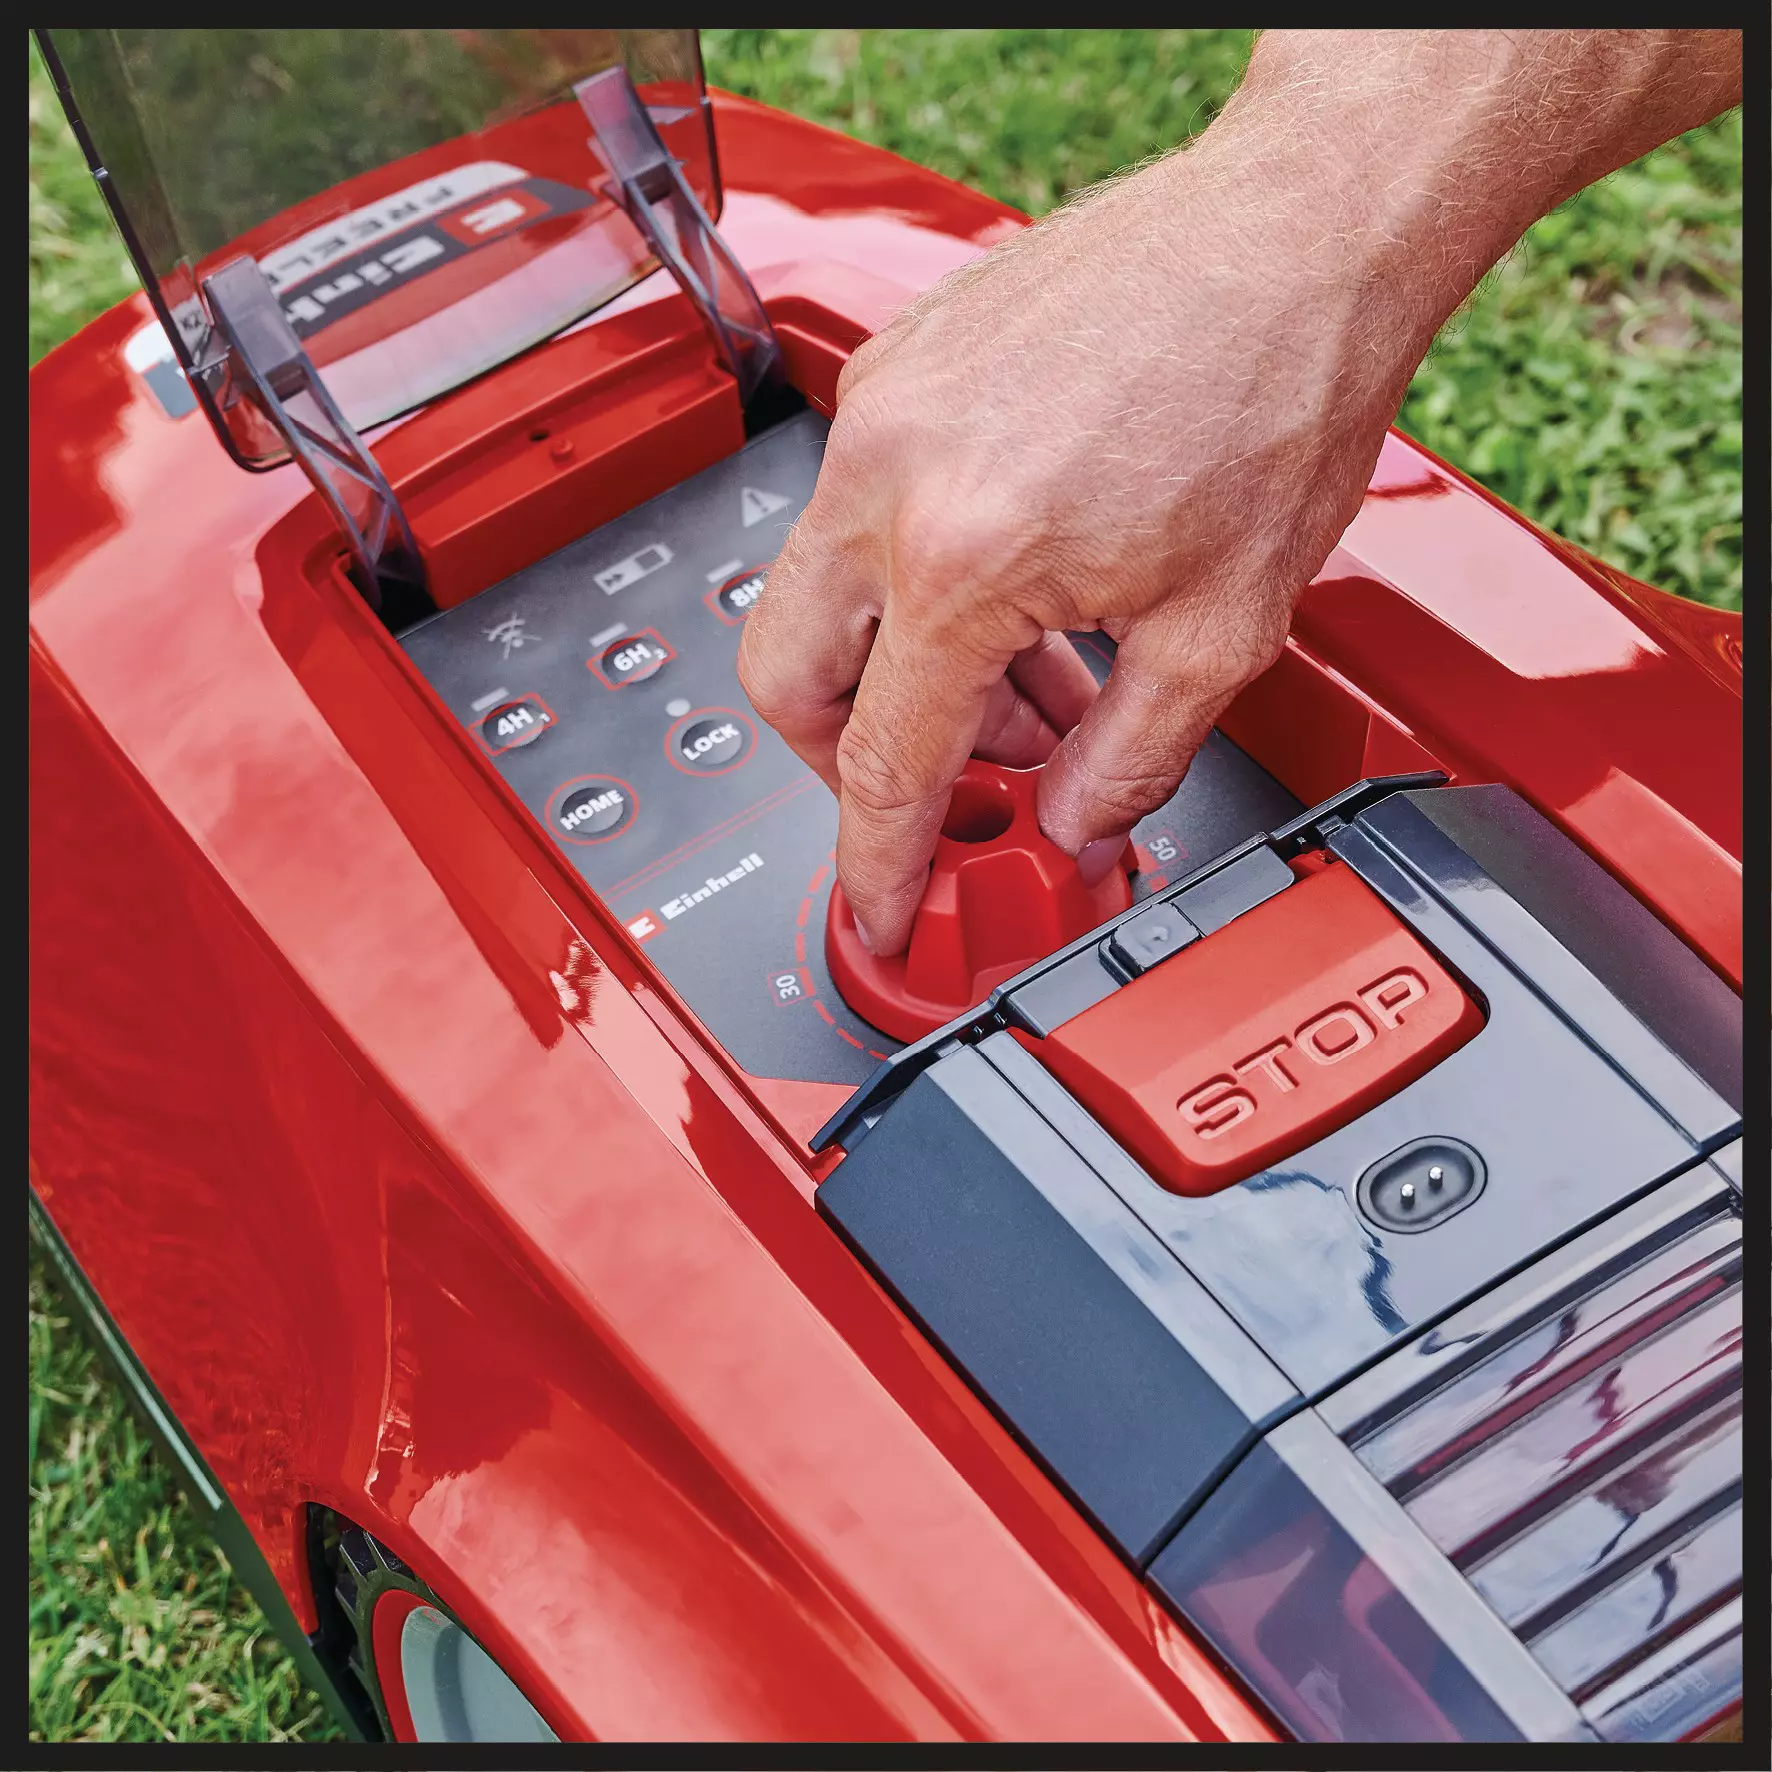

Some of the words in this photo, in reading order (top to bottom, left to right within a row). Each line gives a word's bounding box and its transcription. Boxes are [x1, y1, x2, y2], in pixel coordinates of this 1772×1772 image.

[286, 235, 445, 324] Einh
[613, 643, 652, 672] 6H
[497, 707, 534, 737] 4H
[682, 723, 740, 761] LOCK
[559, 789, 624, 830] HOME
[1149, 837, 1176, 861] 50
[659, 853, 765, 920] Einhell
[775, 974, 801, 999] 30
[1176, 965, 1430, 1140] STOP
